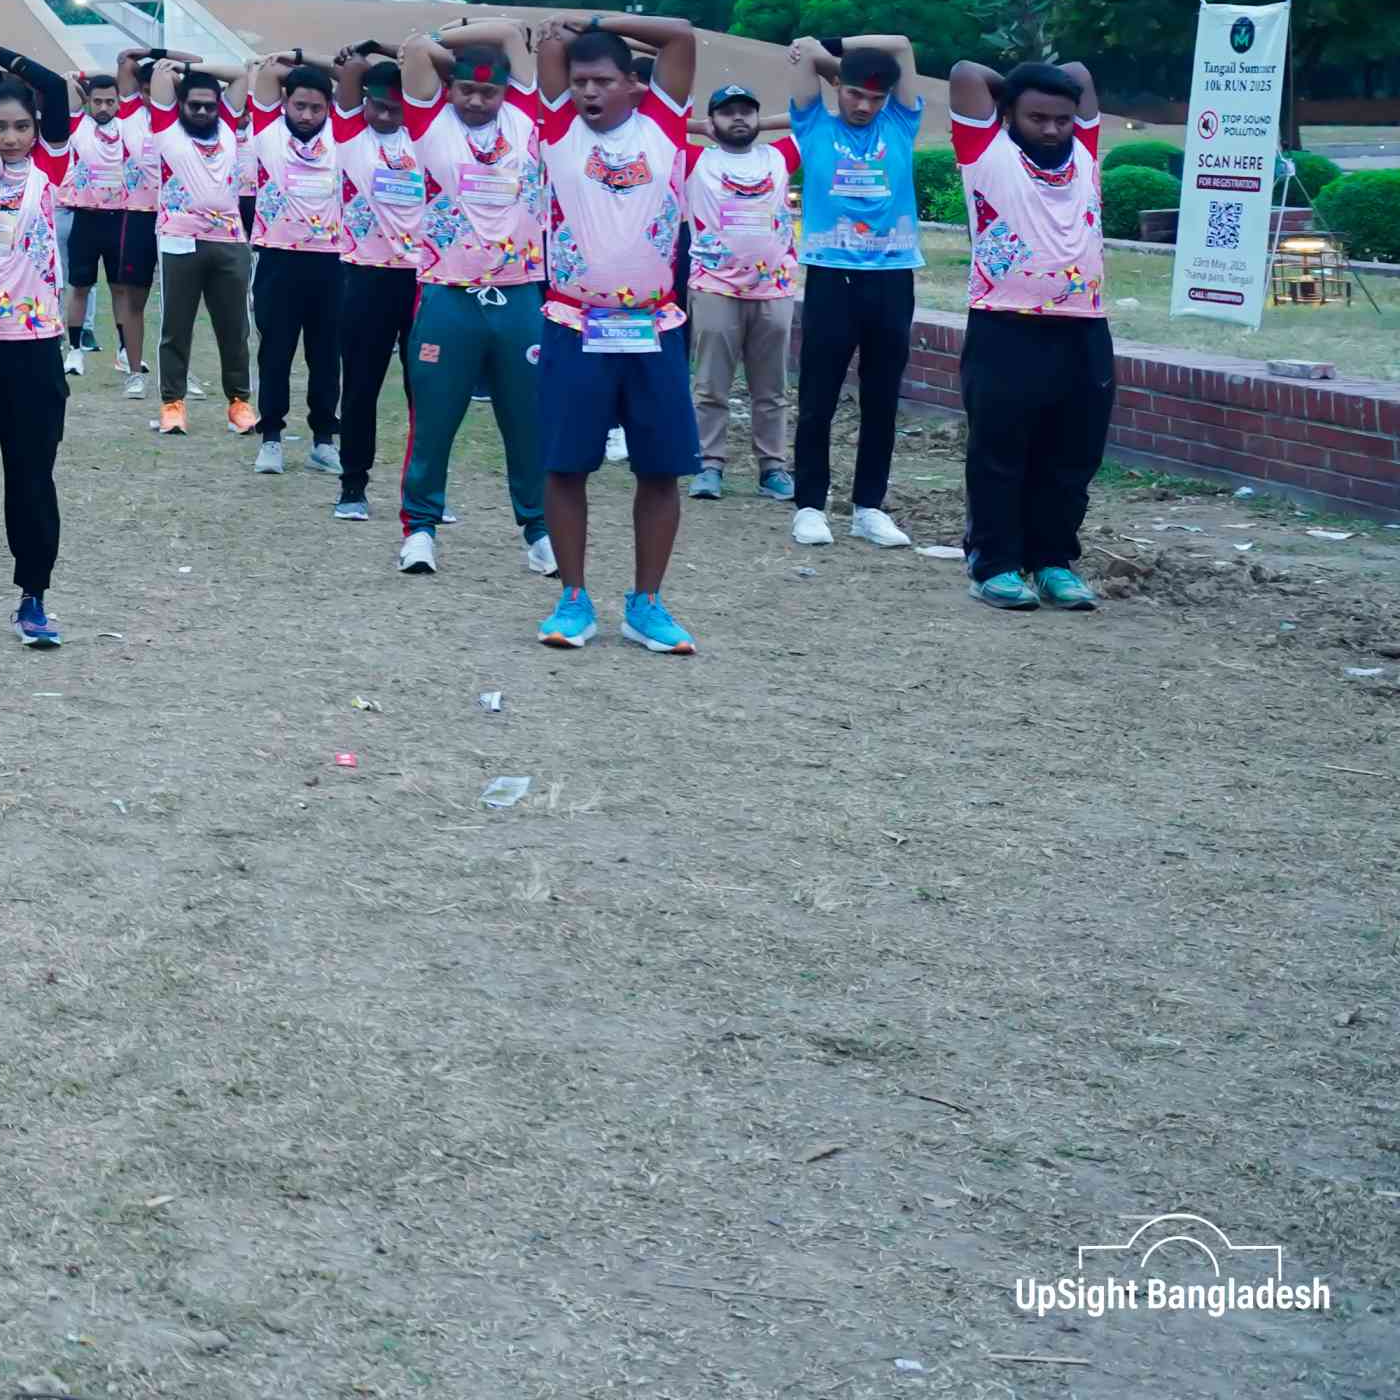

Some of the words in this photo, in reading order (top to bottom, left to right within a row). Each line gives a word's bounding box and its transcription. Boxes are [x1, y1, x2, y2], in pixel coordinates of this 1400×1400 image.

[1224, 80, 1247, 92] RUN
[1222, 115, 1241, 124] STOP
[1243, 115, 1272, 125] SOUND
[1223, 127, 1267, 137] POLLUTION
[1198, 153, 1231, 169] SCAN
[1233, 155, 1264, 170] HERE
